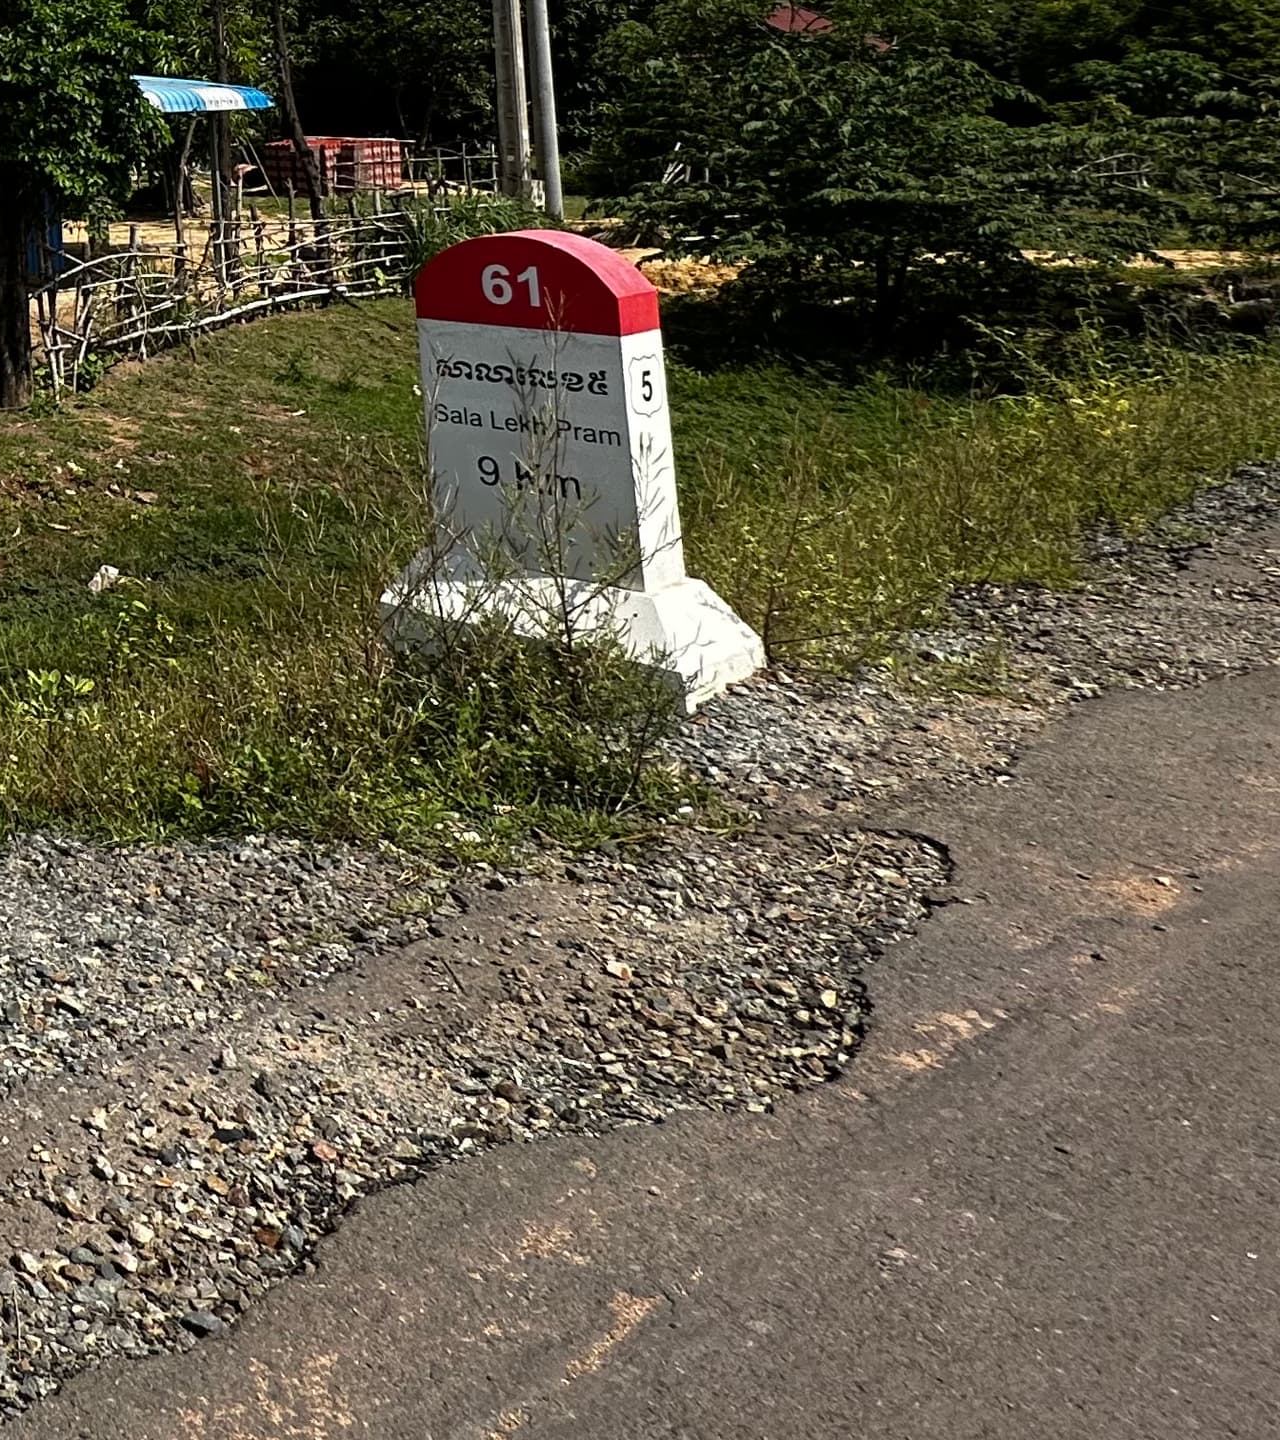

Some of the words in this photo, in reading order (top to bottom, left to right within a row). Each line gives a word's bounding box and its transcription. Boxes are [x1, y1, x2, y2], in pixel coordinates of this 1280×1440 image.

[481, 264, 540, 307] 61
[642, 370, 653, 402] 5
[435, 404, 483, 427] Sala
[491, 411, 546, 436] Lekh
[556, 418, 621, 447] Pram
[477, 456, 500, 486] 9
